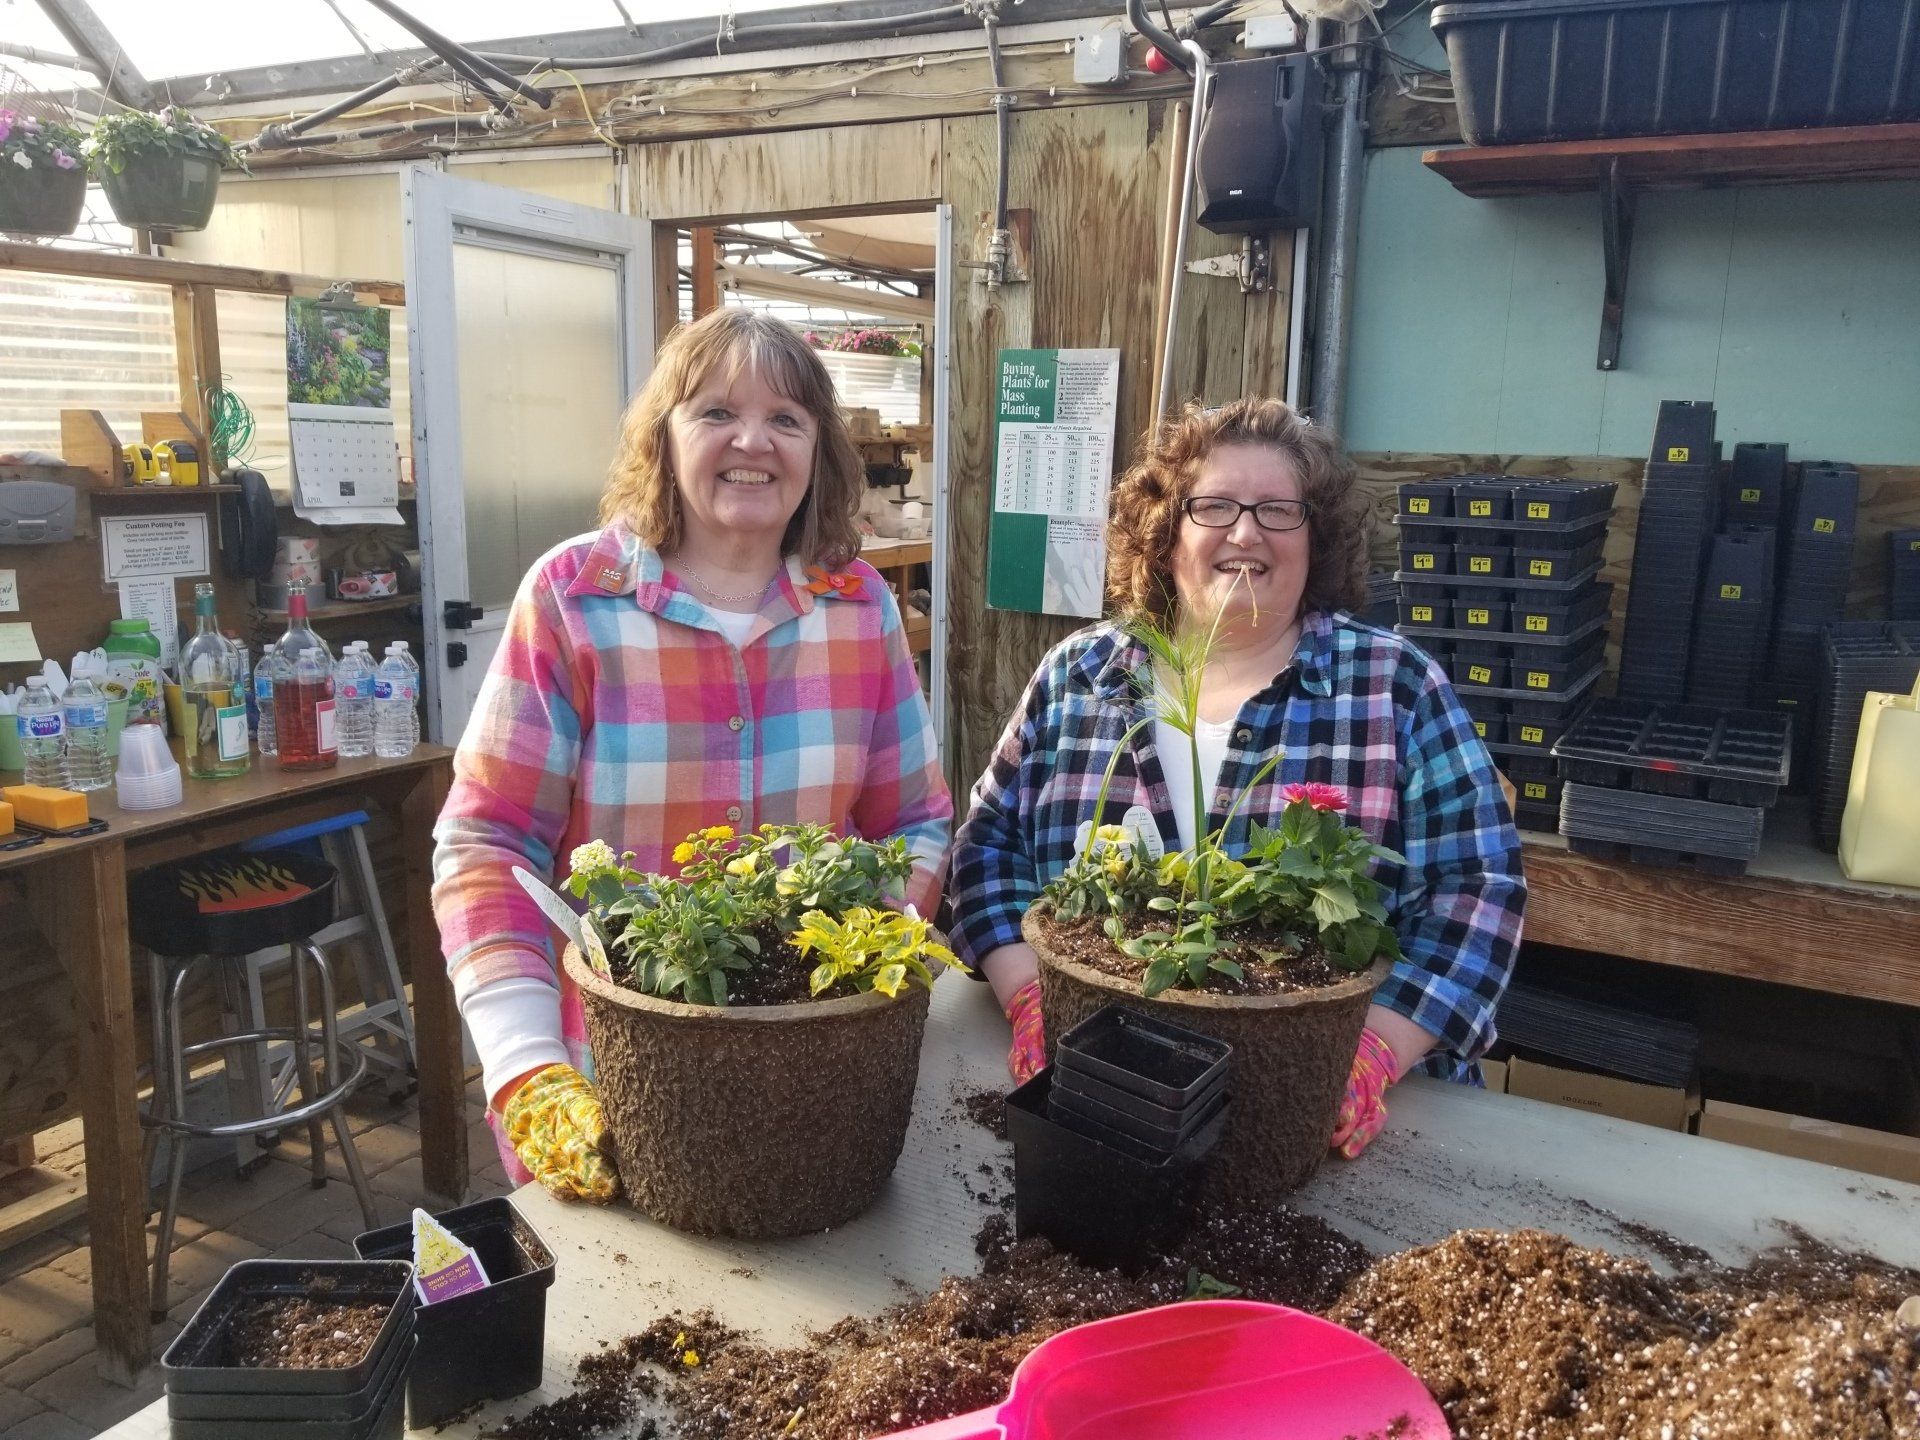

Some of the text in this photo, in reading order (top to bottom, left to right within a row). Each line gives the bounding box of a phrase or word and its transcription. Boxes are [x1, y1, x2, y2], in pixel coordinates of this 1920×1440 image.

[1002, 362, 1035, 378] Buying
[1002, 374, 1050, 388] Plants for
[1002, 388, 1025, 402] Mass
[1000, 402, 1040, 419] Planting
[460, 1268, 470, 1278] HOT
